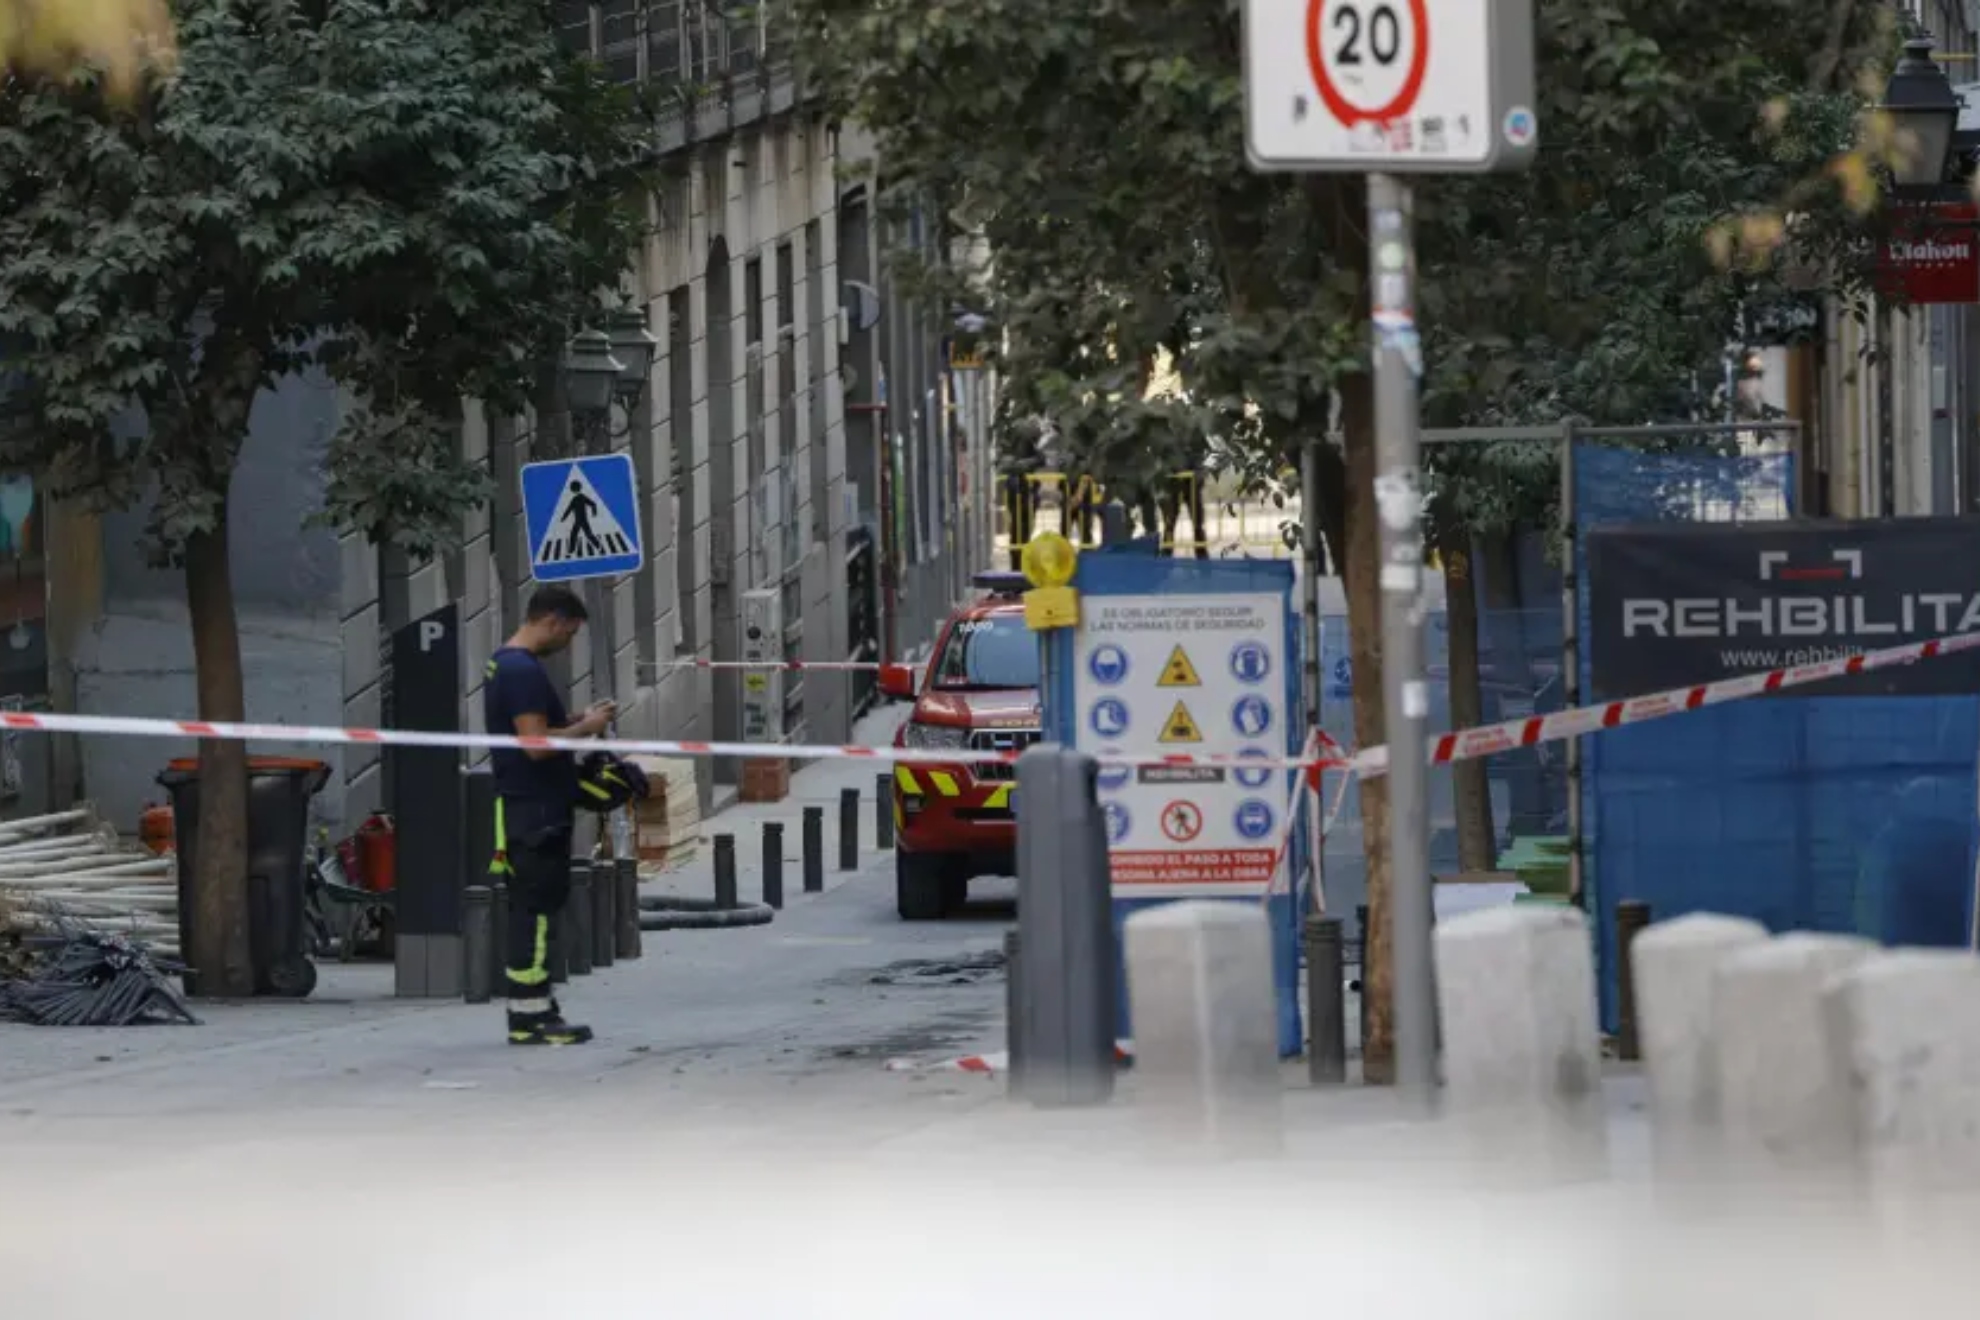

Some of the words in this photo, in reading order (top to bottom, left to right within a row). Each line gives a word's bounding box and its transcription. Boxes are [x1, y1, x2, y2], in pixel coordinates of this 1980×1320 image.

[1333, 4, 1400, 65] 20
[420, 621, 444, 651] P
[1622, 593, 1980, 637] REHBILITA
